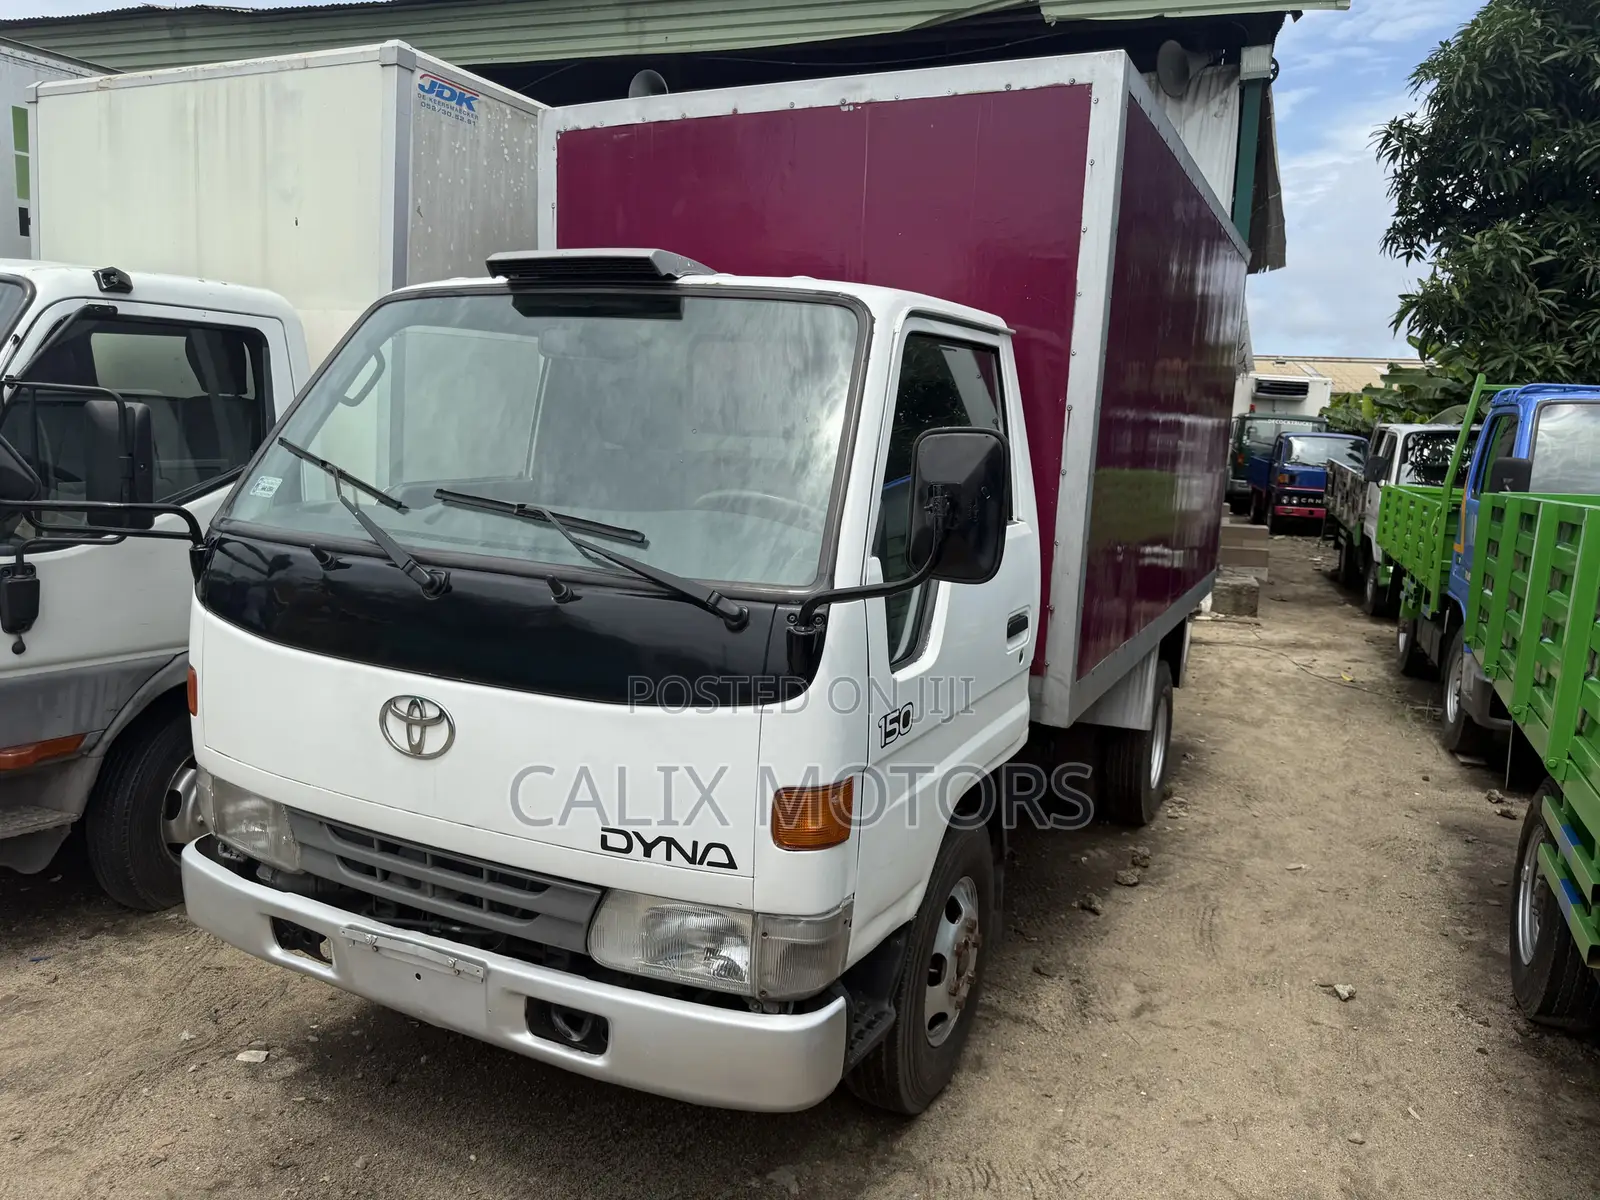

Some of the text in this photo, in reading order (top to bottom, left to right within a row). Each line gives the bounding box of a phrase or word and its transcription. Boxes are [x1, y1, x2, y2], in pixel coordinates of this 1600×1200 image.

[417, 93, 427, 101] DE
[418, 79, 479, 112] JDK
[878, 701, 914, 749] 150
[600, 826, 738, 870] DYNA
